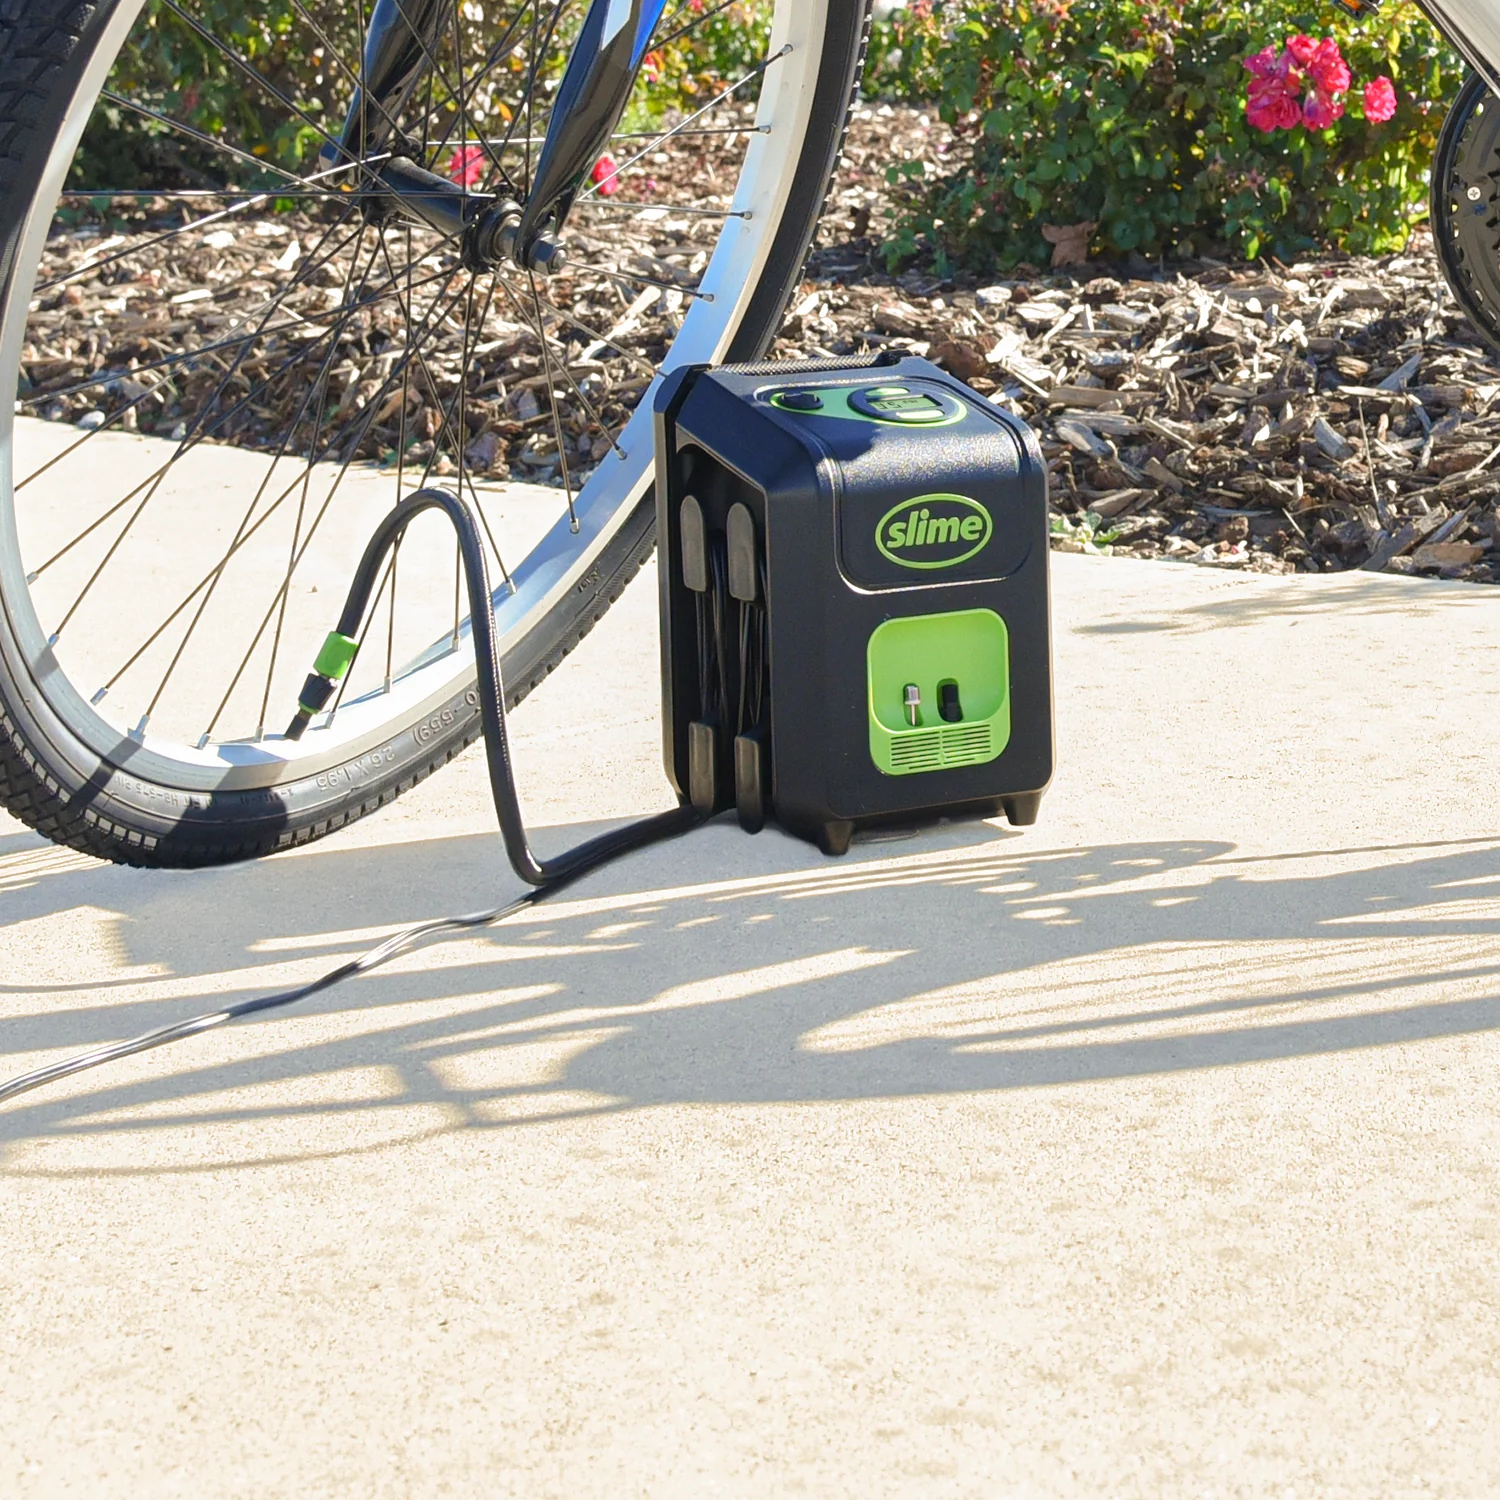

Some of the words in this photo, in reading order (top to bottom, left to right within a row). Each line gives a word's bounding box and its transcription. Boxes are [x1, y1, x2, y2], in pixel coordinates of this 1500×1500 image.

[886, 508, 983, 549] slime
[368, 745, 395, 767] 26
[315, 766, 352, 791] 1.95
